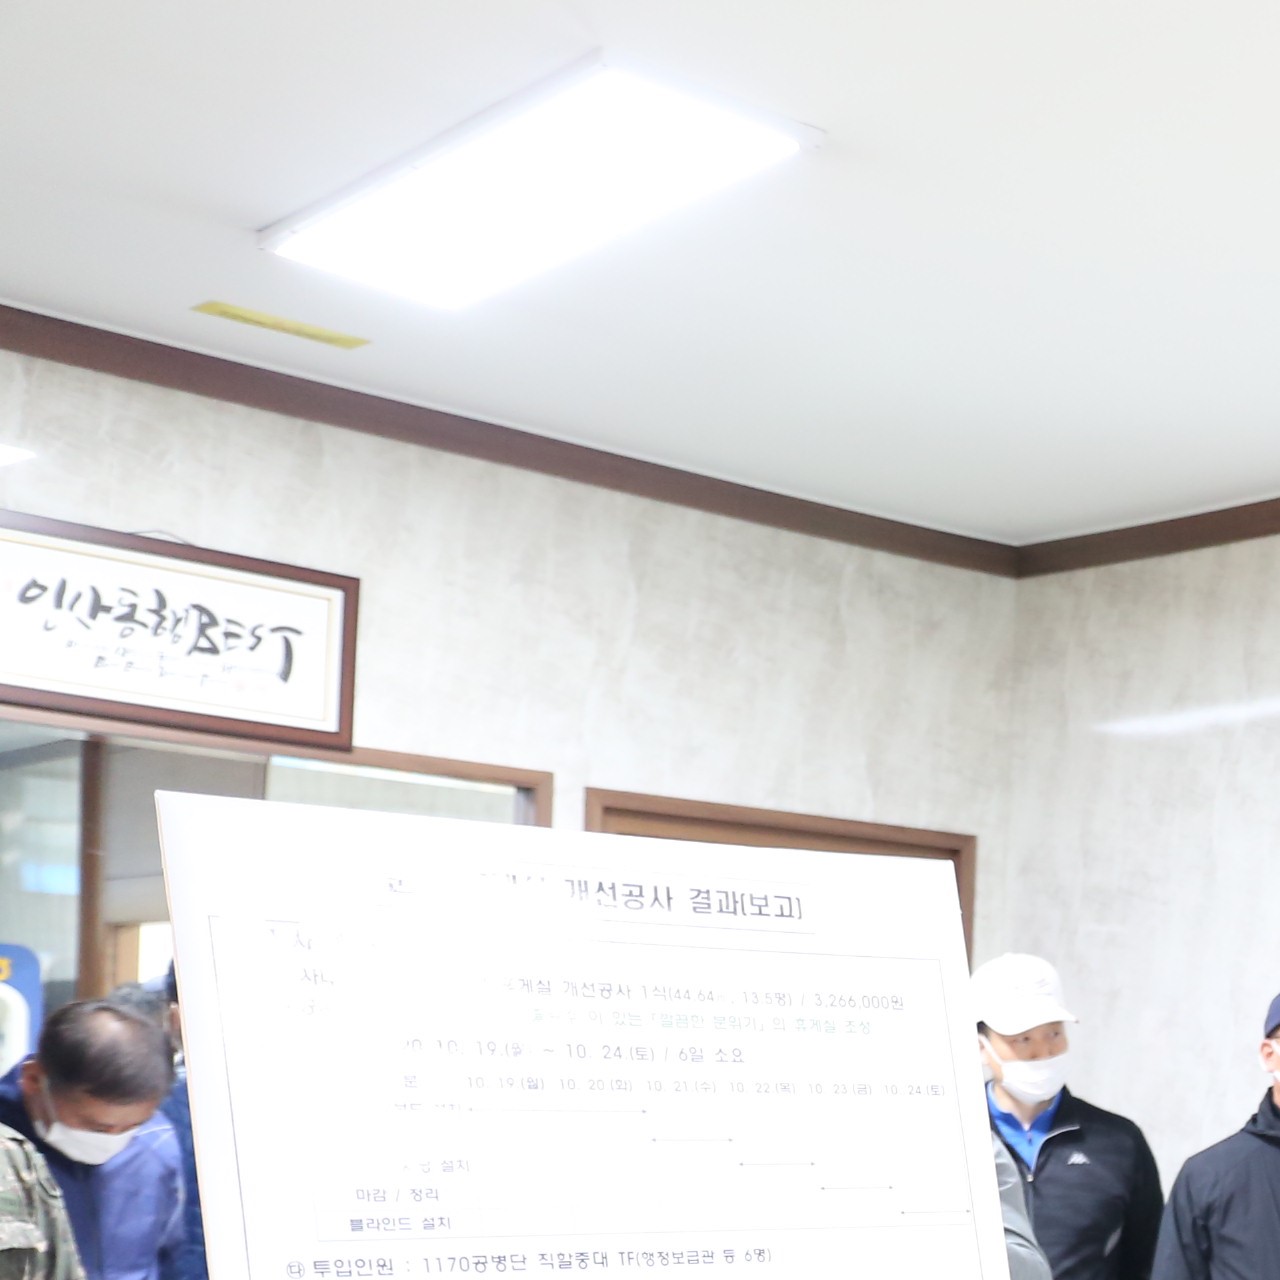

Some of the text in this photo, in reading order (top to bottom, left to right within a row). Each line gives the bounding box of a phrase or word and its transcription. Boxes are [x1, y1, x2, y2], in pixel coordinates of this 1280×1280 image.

[565, 879, 803, 920] 개선공사 결과(보고)
[563, 981, 631, 1000] 개선공사
[795, 1017, 837, 1034] 휴게실
[845, 1019, 871, 1035] 조성
[678, 1046, 705, 1063] 6일
[715, 1047, 744, 1063] 소요
[440, 1159, 471, 1173] 설치
[356, 1188, 387, 1202] 마감
[410, 1188, 439, 1202] 정리
[350, 1216, 451, 1232] 블라인드 설치
[313, 1258, 394, 1278] 투입인원
[423, 1254, 527, 1273] 1170공병단
[538, 1251, 608, 1270] 직할중대
[618, 1250, 715, 1268] TF(행정보급관
[722, 1249, 736, 1264] 등
[744, 1248, 772, 1263] 6명)
